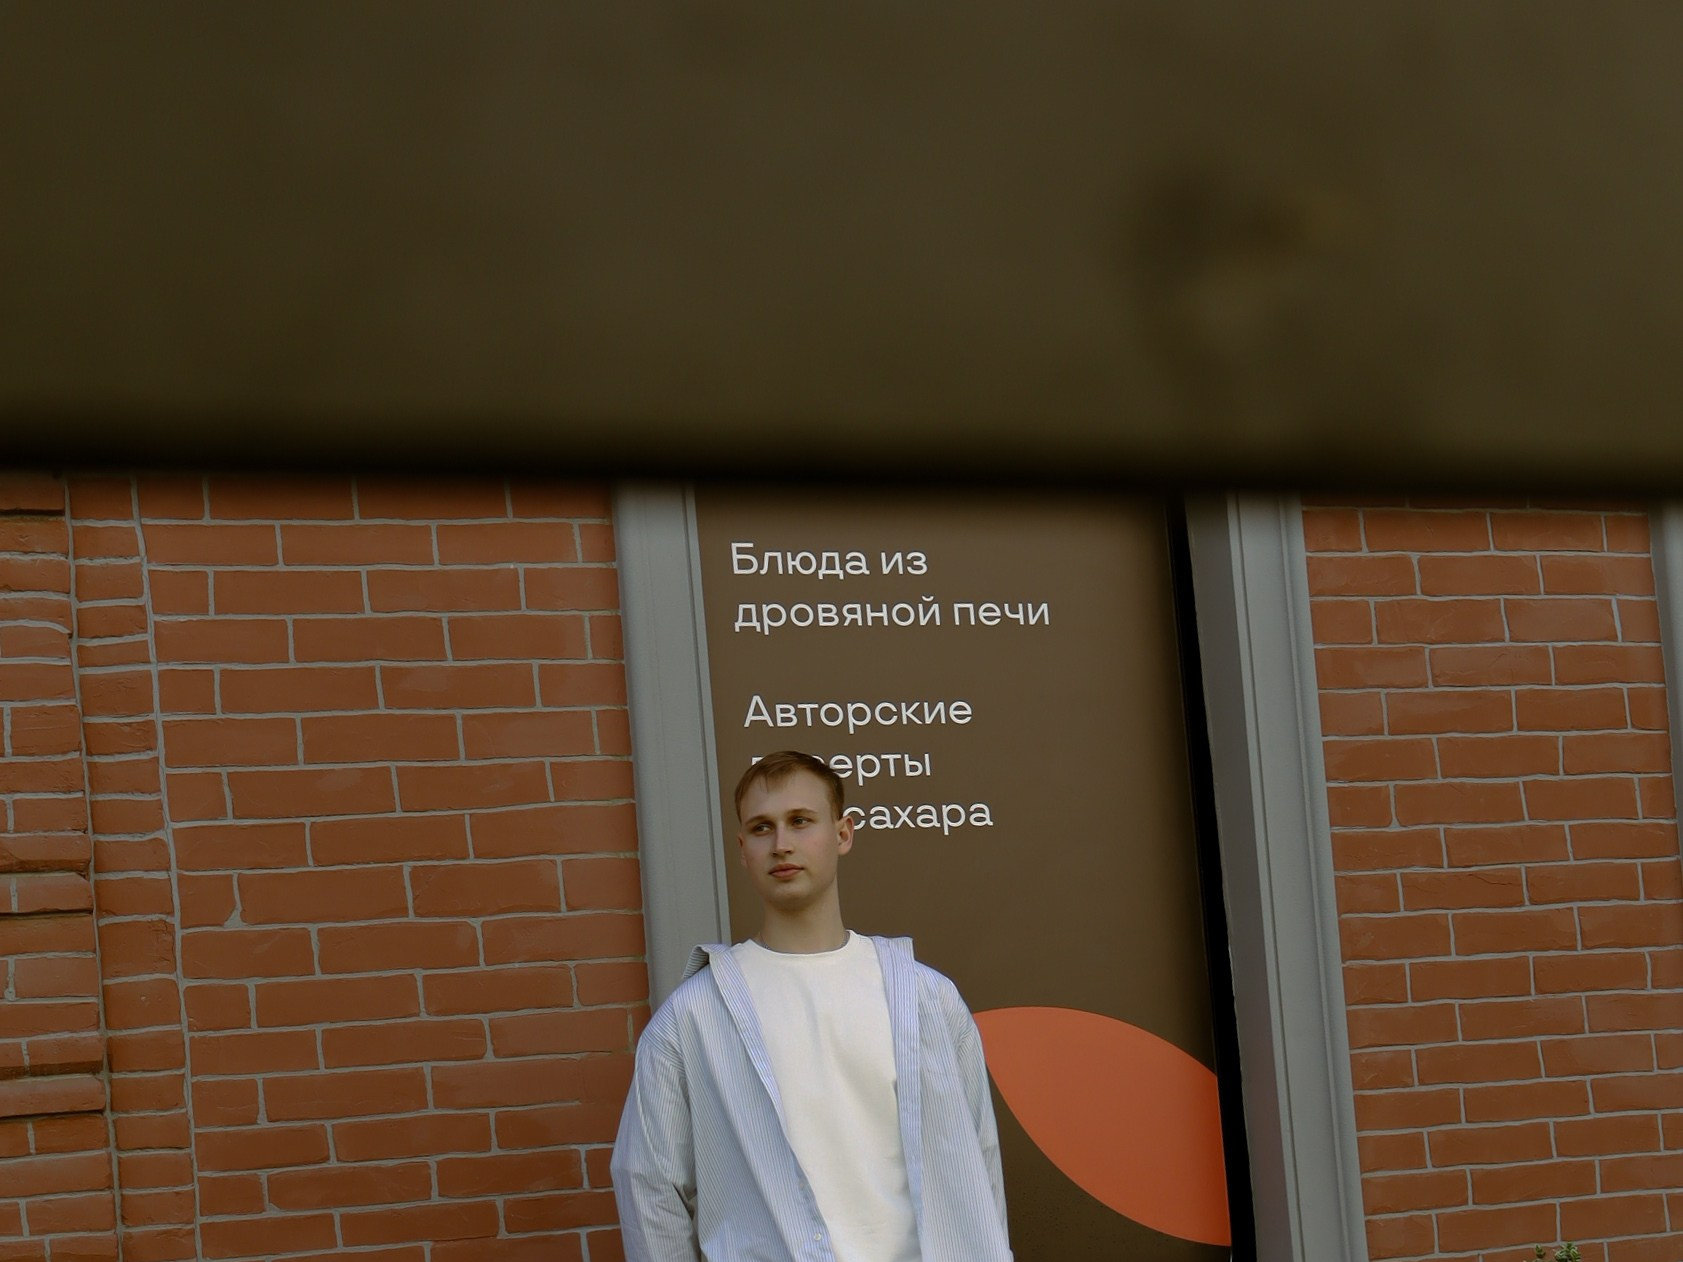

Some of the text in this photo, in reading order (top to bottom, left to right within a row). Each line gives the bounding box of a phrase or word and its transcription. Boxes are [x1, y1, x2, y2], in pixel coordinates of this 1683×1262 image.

[731, 542, 928, 580] Блюда из
[734, 595, 1050, 636] дровяной печи
[743, 695, 973, 735] Авторские
[751, 753, 932, 786] ерты
[842, 803, 994, 836] сахара
